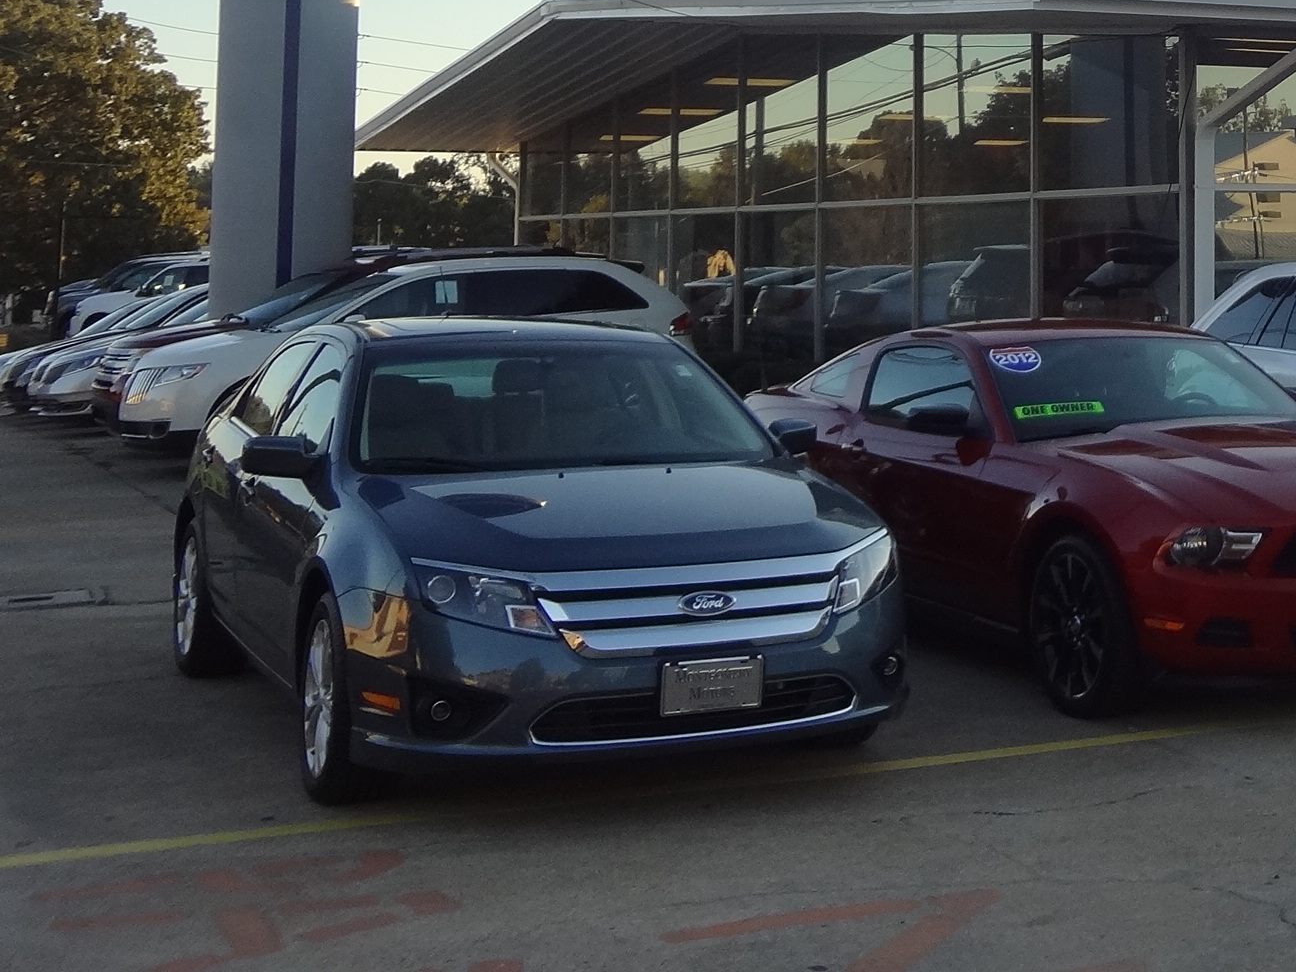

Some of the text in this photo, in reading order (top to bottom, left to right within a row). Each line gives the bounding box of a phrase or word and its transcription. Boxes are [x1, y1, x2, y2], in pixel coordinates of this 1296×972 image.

[995, 352, 1039, 365] 2012
[1021, 402, 1094, 416] ONE OWNER
[693, 595, 724, 609] Ford
